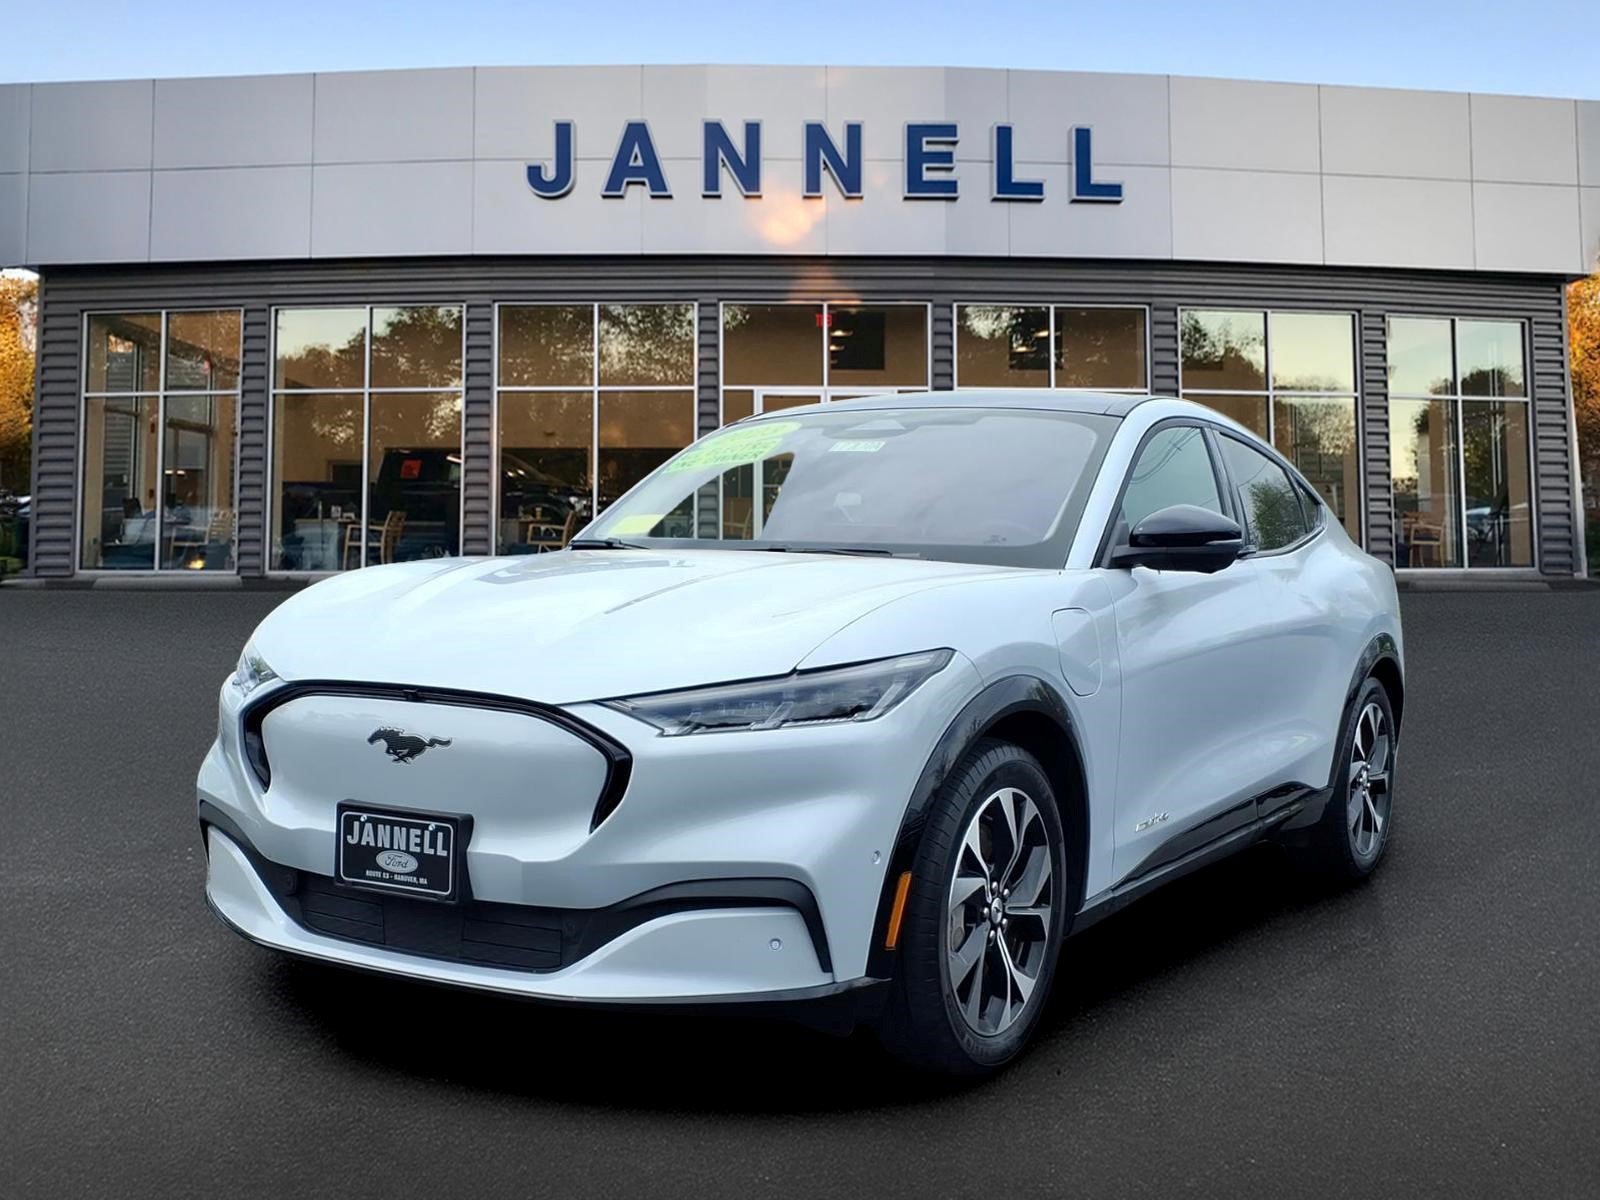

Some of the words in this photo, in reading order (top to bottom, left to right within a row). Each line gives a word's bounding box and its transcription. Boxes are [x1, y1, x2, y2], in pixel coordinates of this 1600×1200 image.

[526, 119, 1124, 203] JANNELL
[346, 821, 448, 857] JANNELL
[385, 853, 409, 868] Ford
